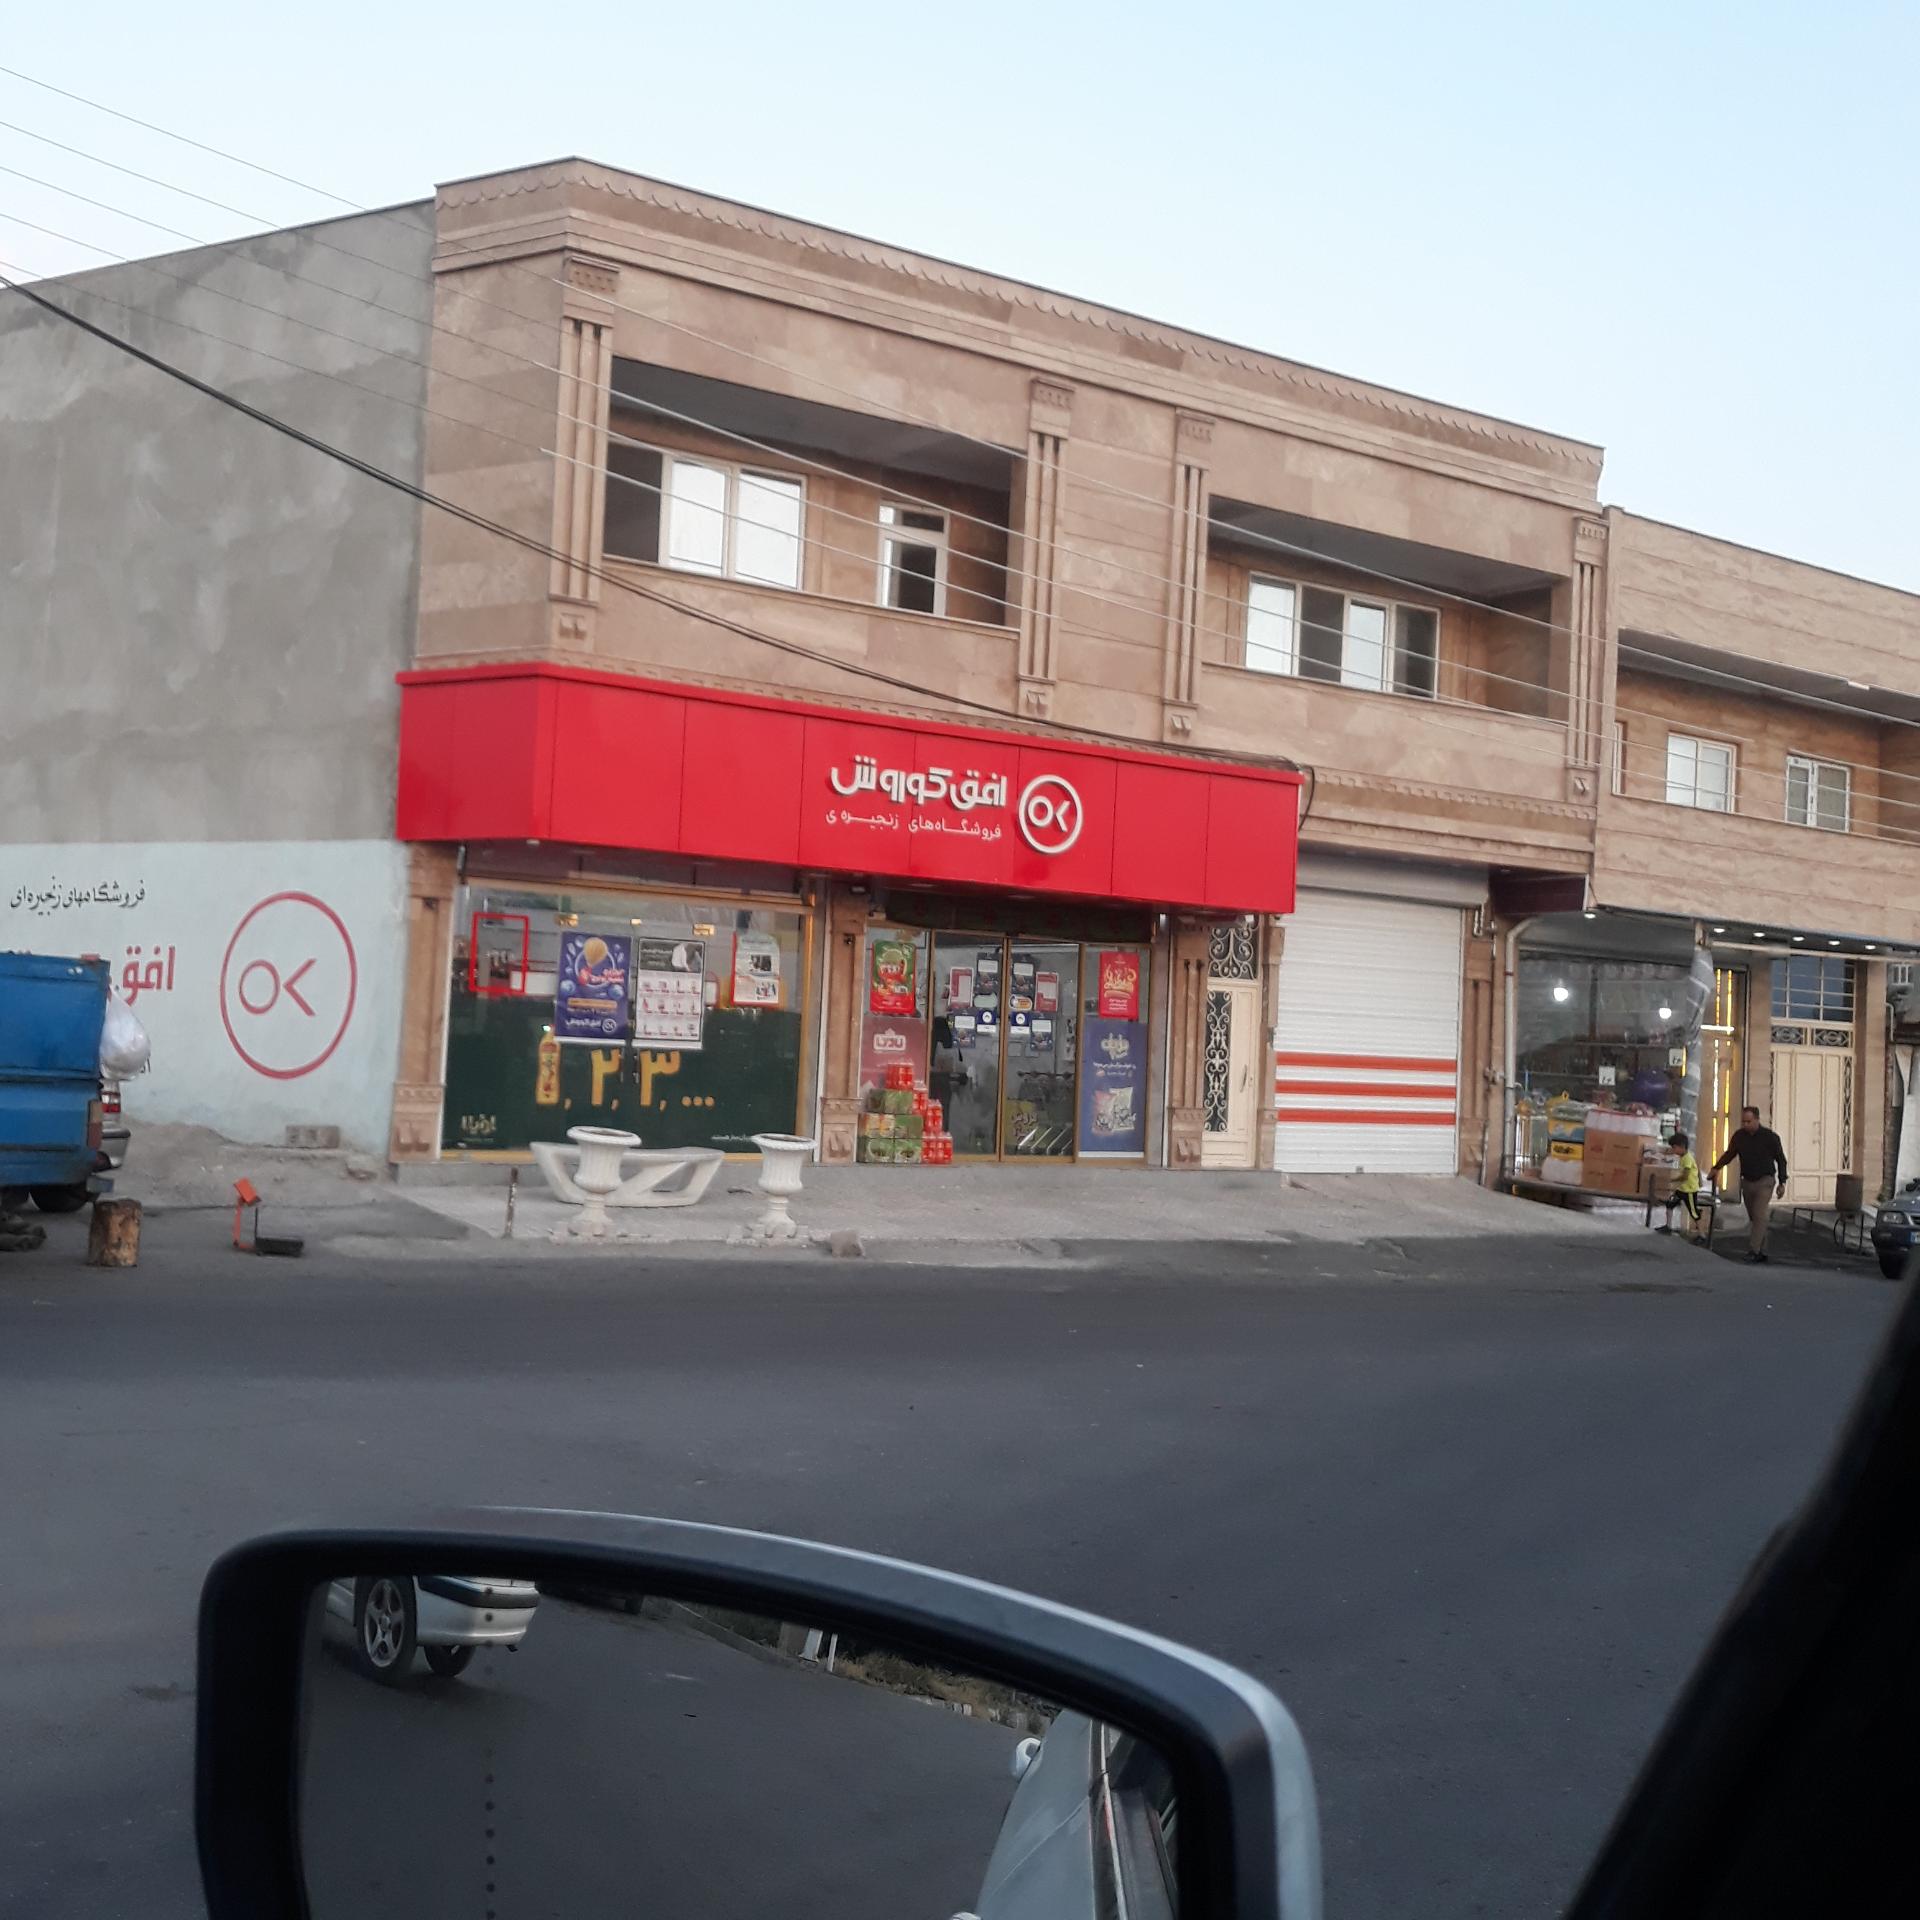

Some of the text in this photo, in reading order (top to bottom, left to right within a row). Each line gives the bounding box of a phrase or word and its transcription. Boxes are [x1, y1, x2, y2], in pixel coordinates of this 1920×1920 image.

[831, 754, 1008, 811] افق کوروش
[238, 958, 318, 1017] OK
